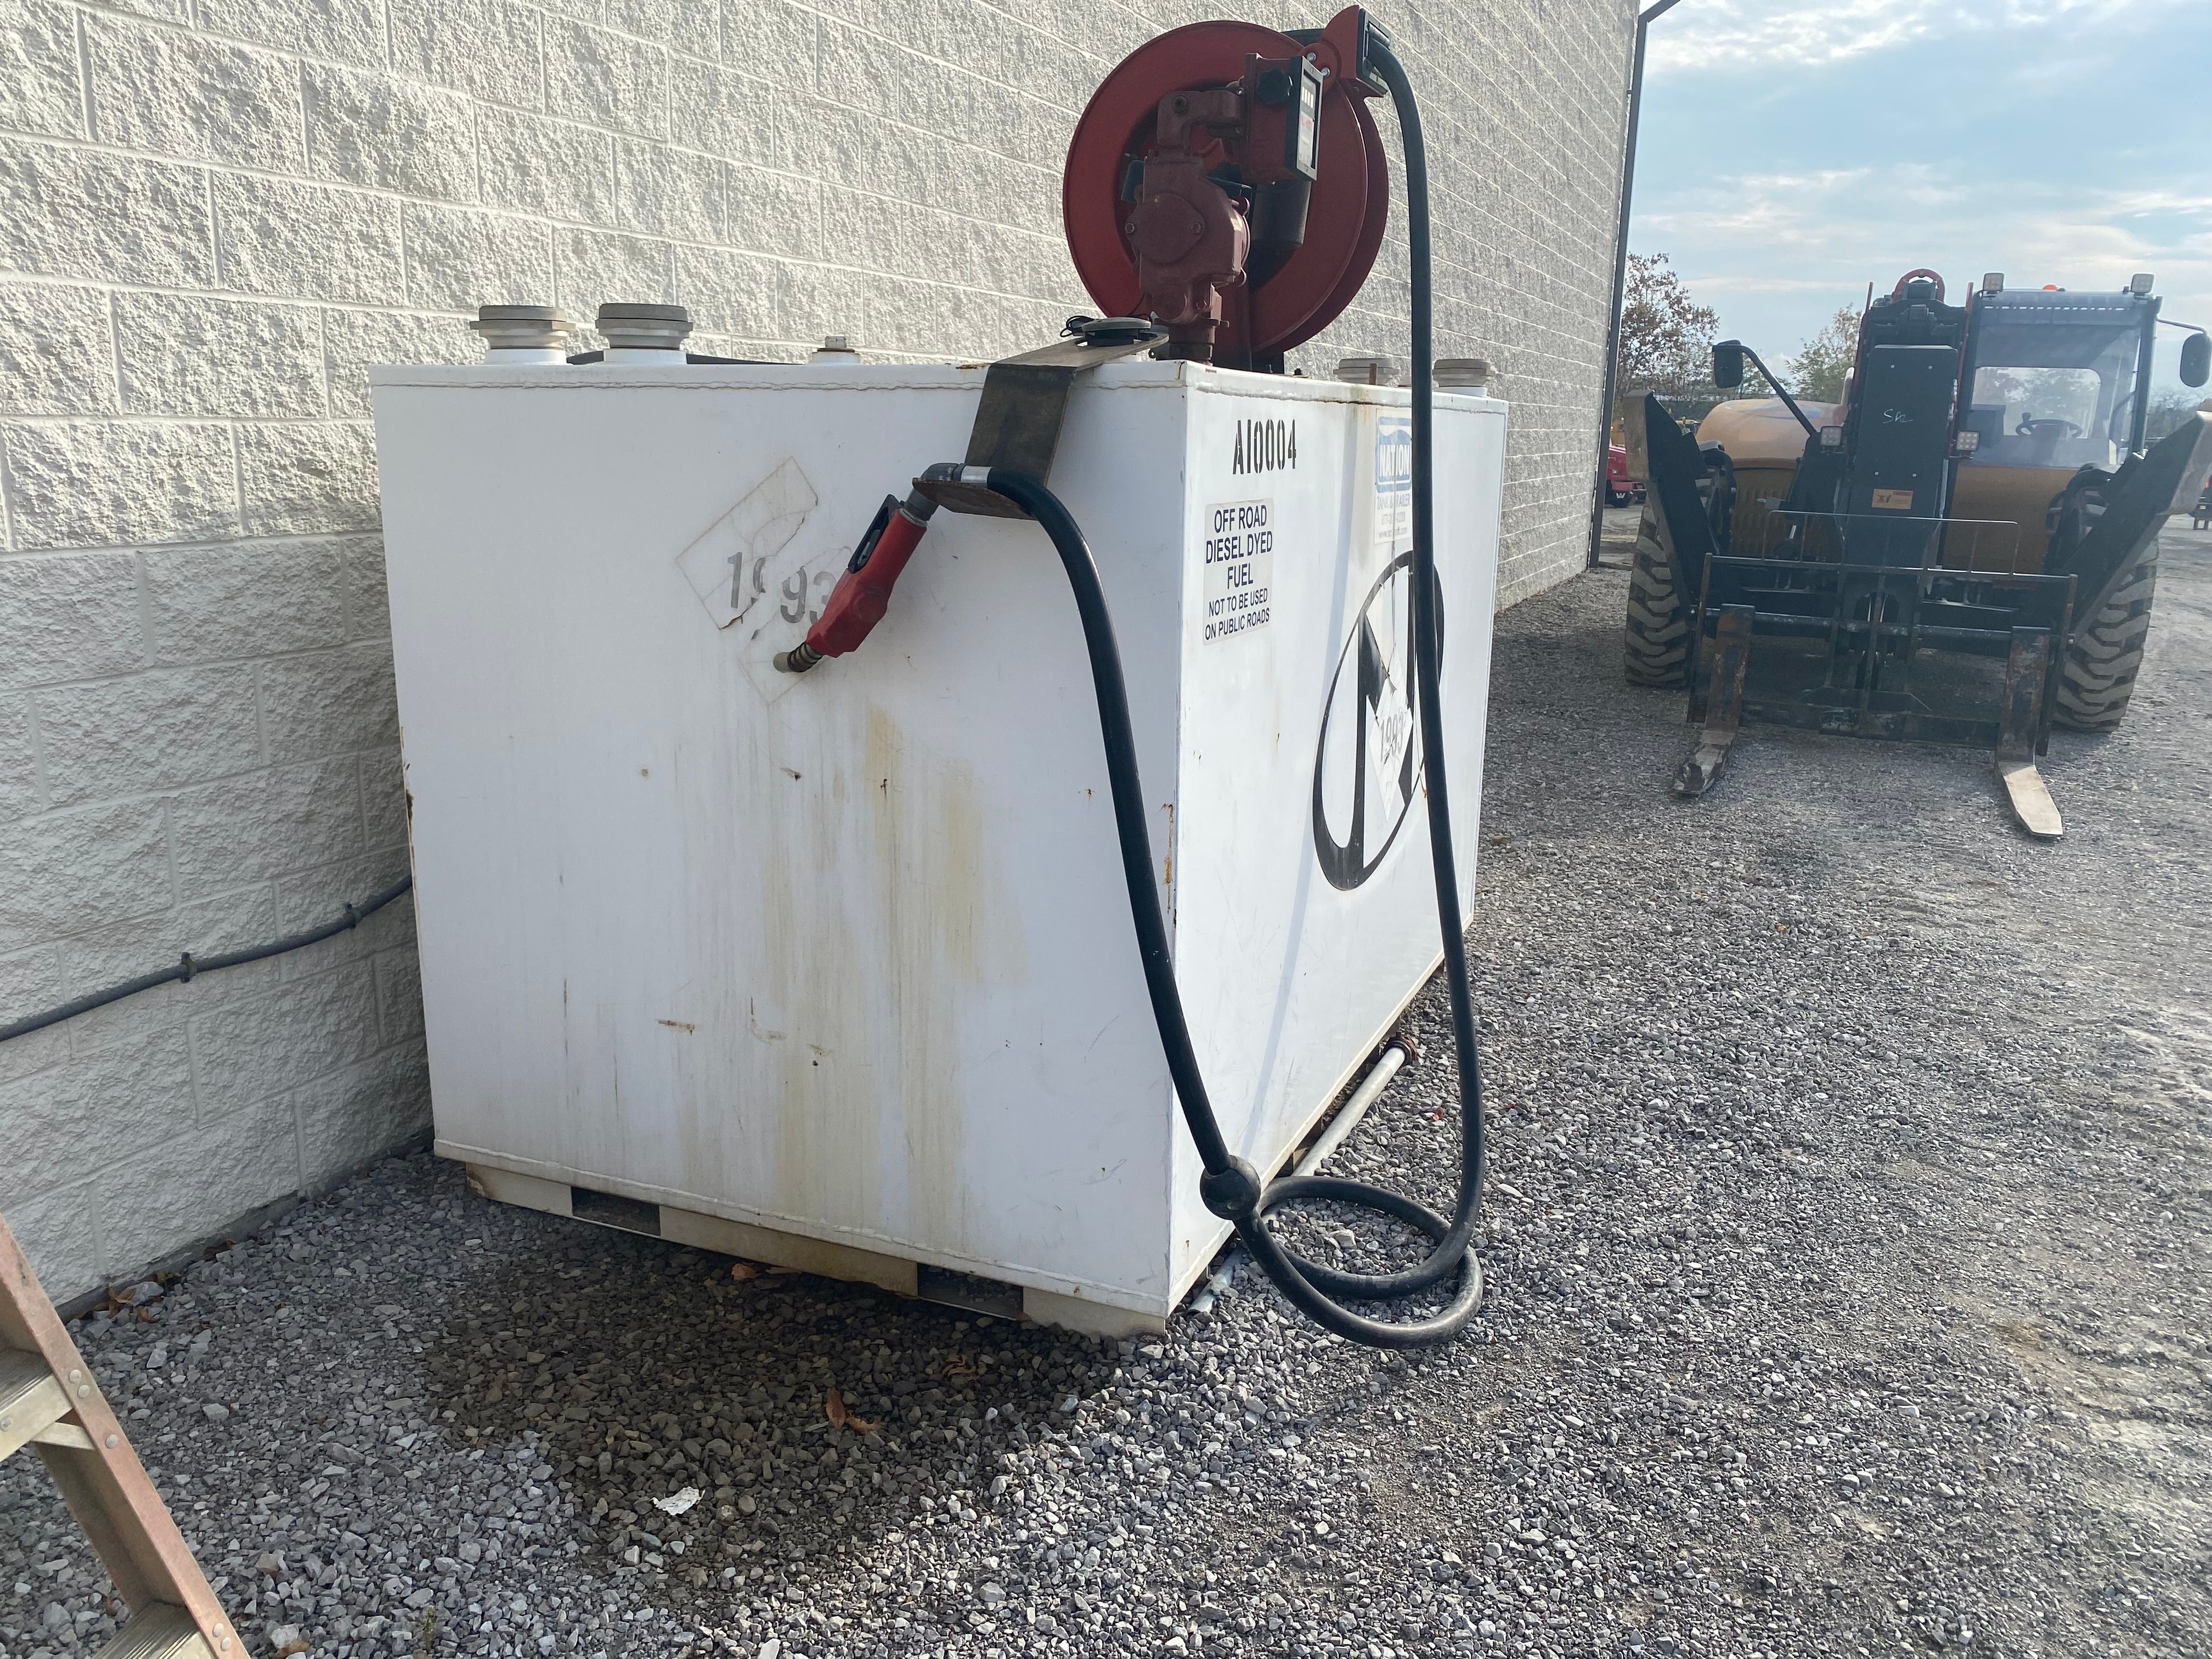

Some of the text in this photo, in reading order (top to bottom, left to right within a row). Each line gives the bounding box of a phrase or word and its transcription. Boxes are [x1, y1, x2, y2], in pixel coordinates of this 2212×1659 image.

[1379, 444, 1409, 477] NATION
[1214, 505, 1267, 533] OFF ROAD
[1206, 531, 1273, 564] DIESEL DYED
[1227, 563, 1254, 590] FUEL
[1209, 588, 1268, 617] NOT TO BE USED
[1205, 607, 1270, 640] ON PUBLIC ROADS
